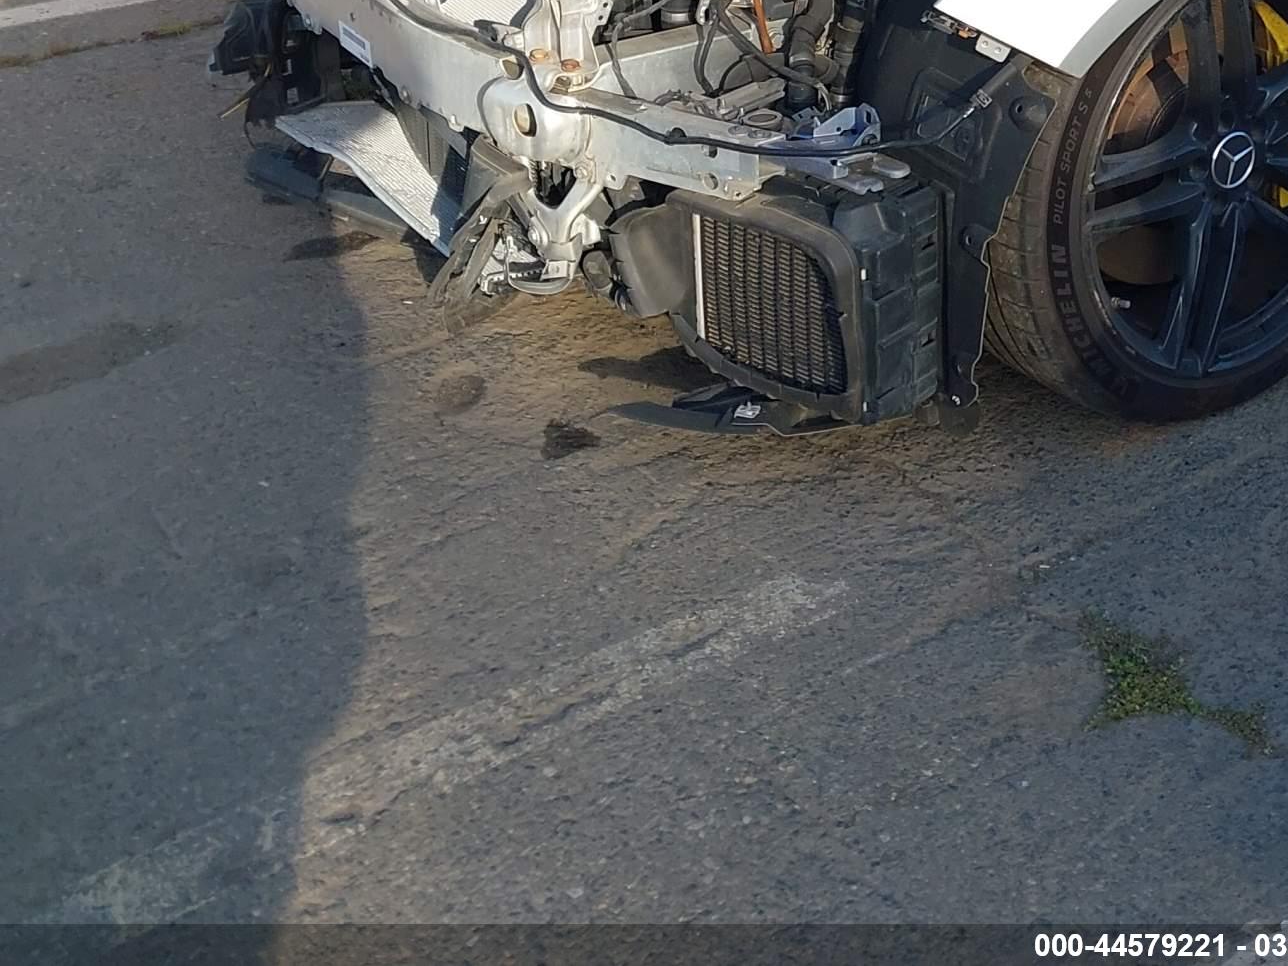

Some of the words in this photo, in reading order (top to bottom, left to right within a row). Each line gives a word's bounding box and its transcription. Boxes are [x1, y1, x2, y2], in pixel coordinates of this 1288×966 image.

[1078, 102, 1089, 115] S
[1060, 115, 1083, 173] SPORT
[1053, 178, 1068, 225] PILOT
[1051, 244, 1113, 377] MICHELIN
